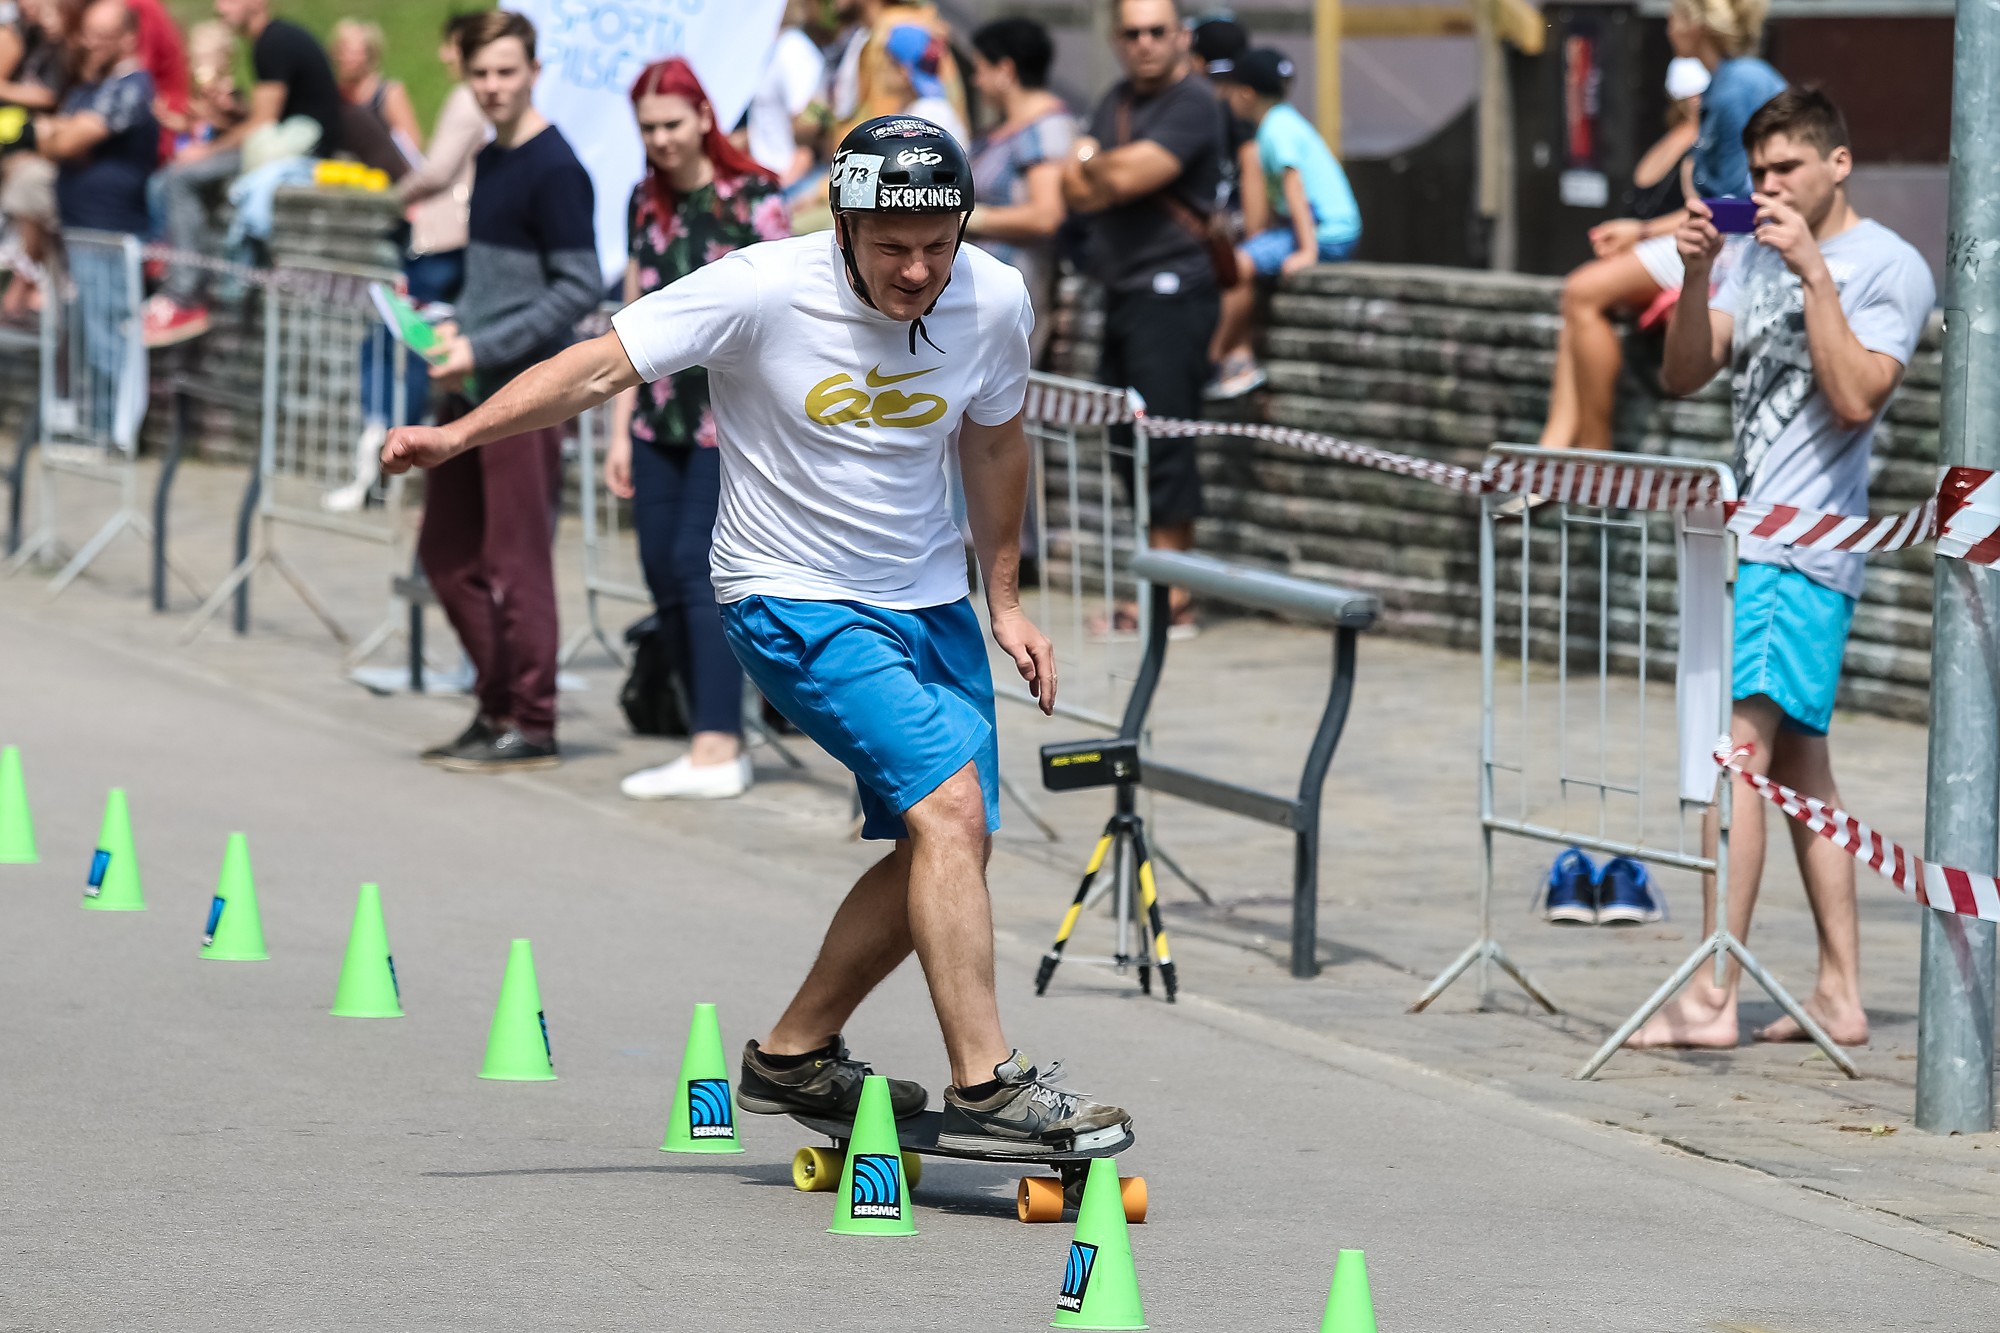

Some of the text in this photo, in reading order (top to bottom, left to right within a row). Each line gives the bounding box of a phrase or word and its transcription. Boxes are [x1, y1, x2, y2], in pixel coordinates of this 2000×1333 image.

[847, 166, 869, 185] 73
[879, 187, 962, 208] SK8KINGS
[692, 1125, 734, 1137] SEISMIC
[853, 1205, 900, 1217] SEISMIC
[1057, 1294, 1081, 1310] SMIC
